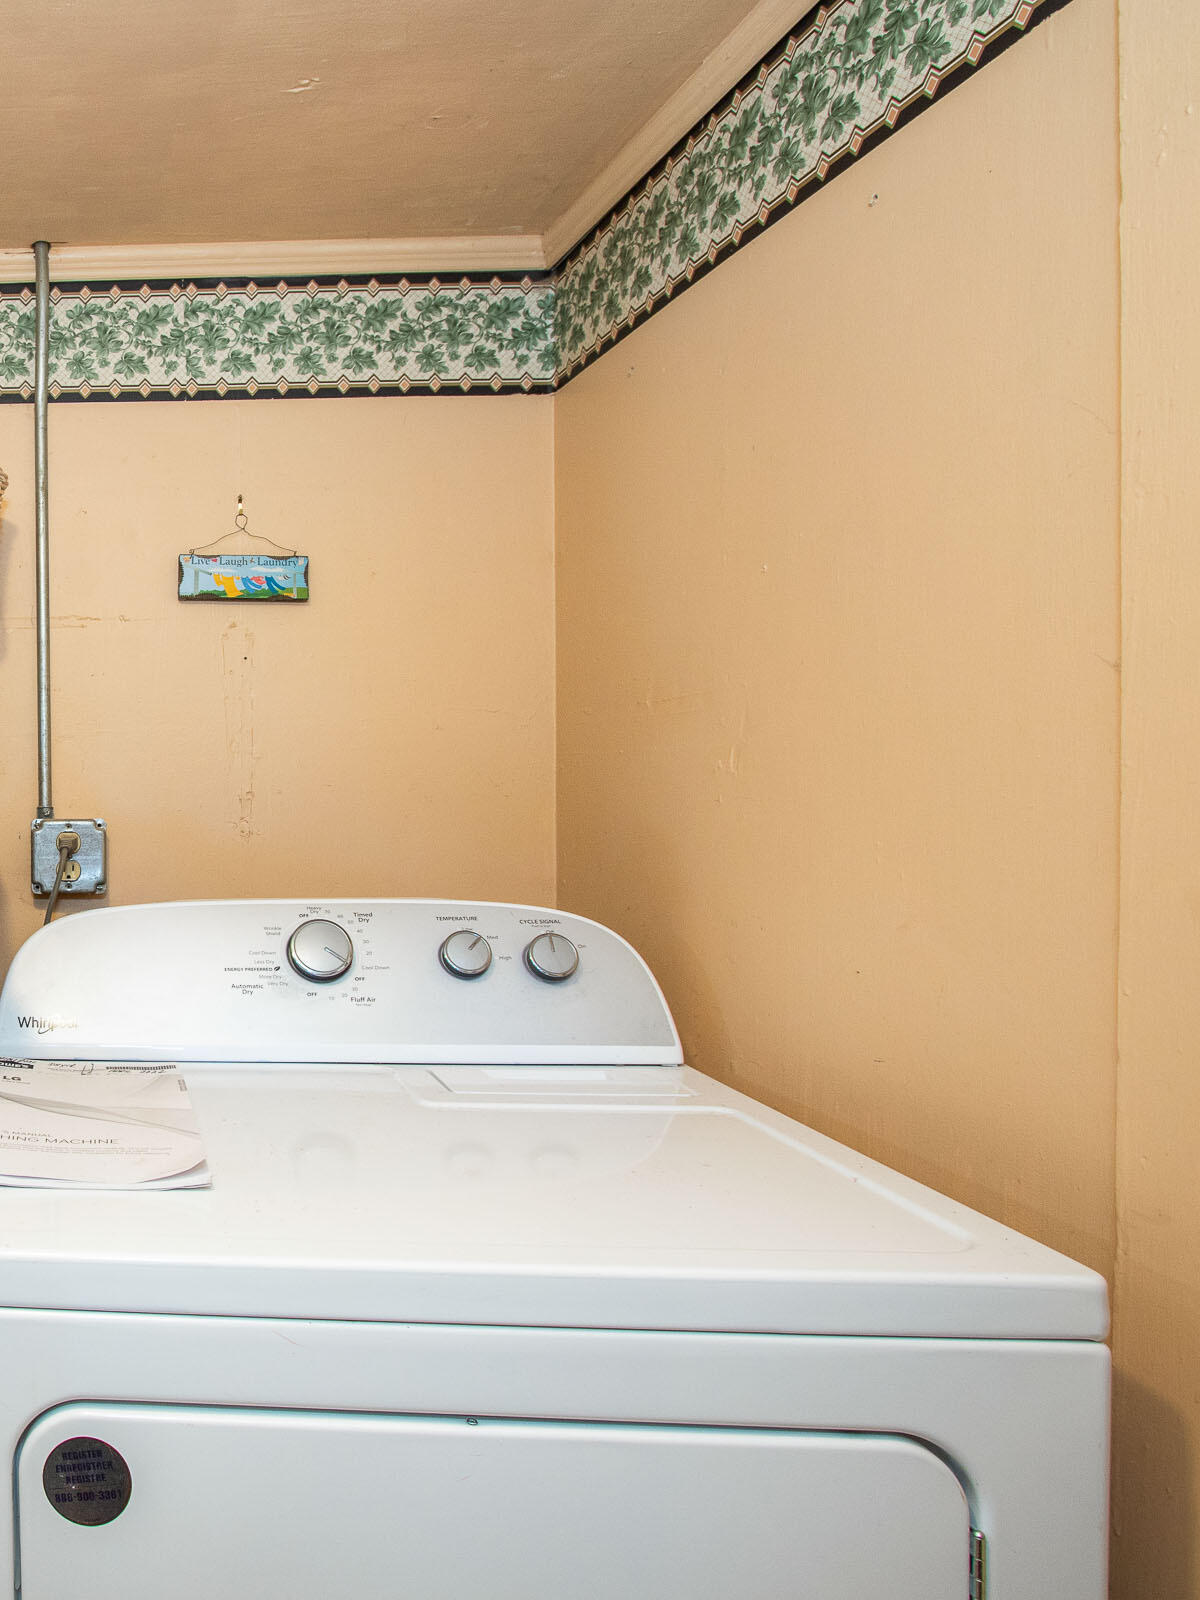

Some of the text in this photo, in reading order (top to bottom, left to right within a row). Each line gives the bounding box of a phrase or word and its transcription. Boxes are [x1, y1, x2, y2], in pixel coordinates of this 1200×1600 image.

[191, 556, 298, 568] Live Laugh Laundry
[62, 1450, 103, 1460] REGISTER
